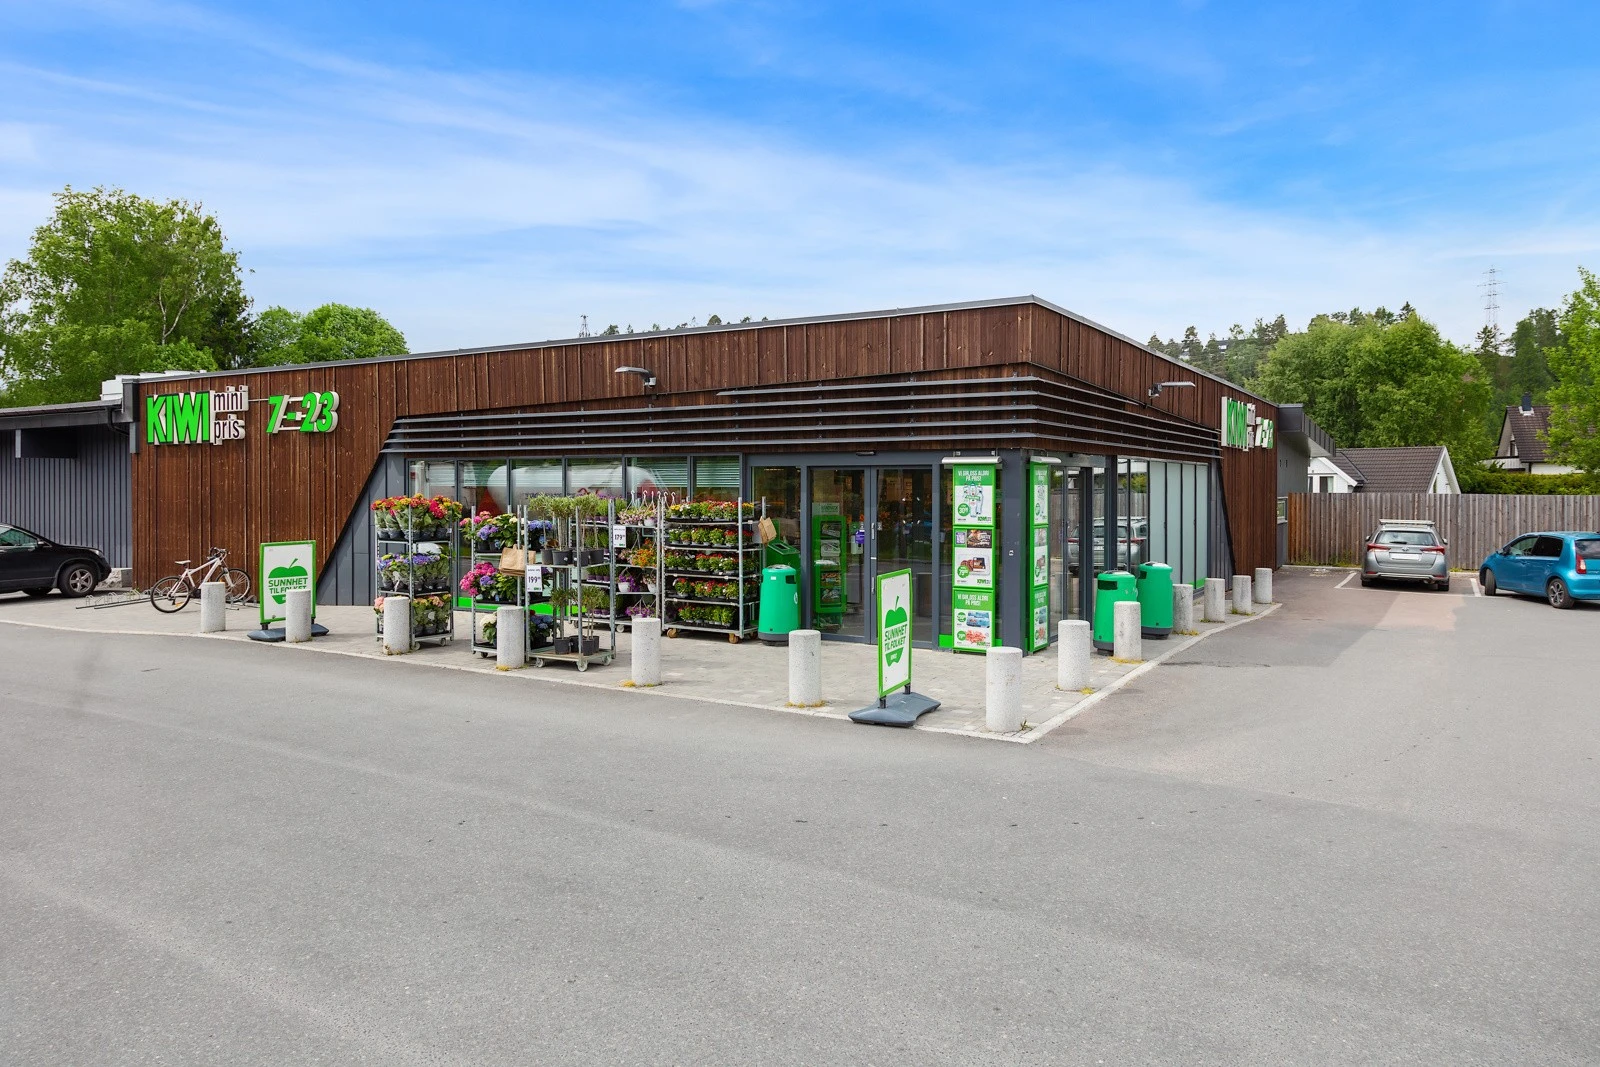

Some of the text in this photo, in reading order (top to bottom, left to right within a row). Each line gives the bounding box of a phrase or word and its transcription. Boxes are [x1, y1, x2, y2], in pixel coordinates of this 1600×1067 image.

[213, 385, 248, 411] mini
[146, 391, 211, 445] KIWI
[266, 391, 337, 433] 7-23
[213, 414, 243, 445] pris
[268, 577, 308, 587] SUNNHET
[884, 624, 908, 642] SUNNHET
[890, 636, 906, 649] FOLKET
